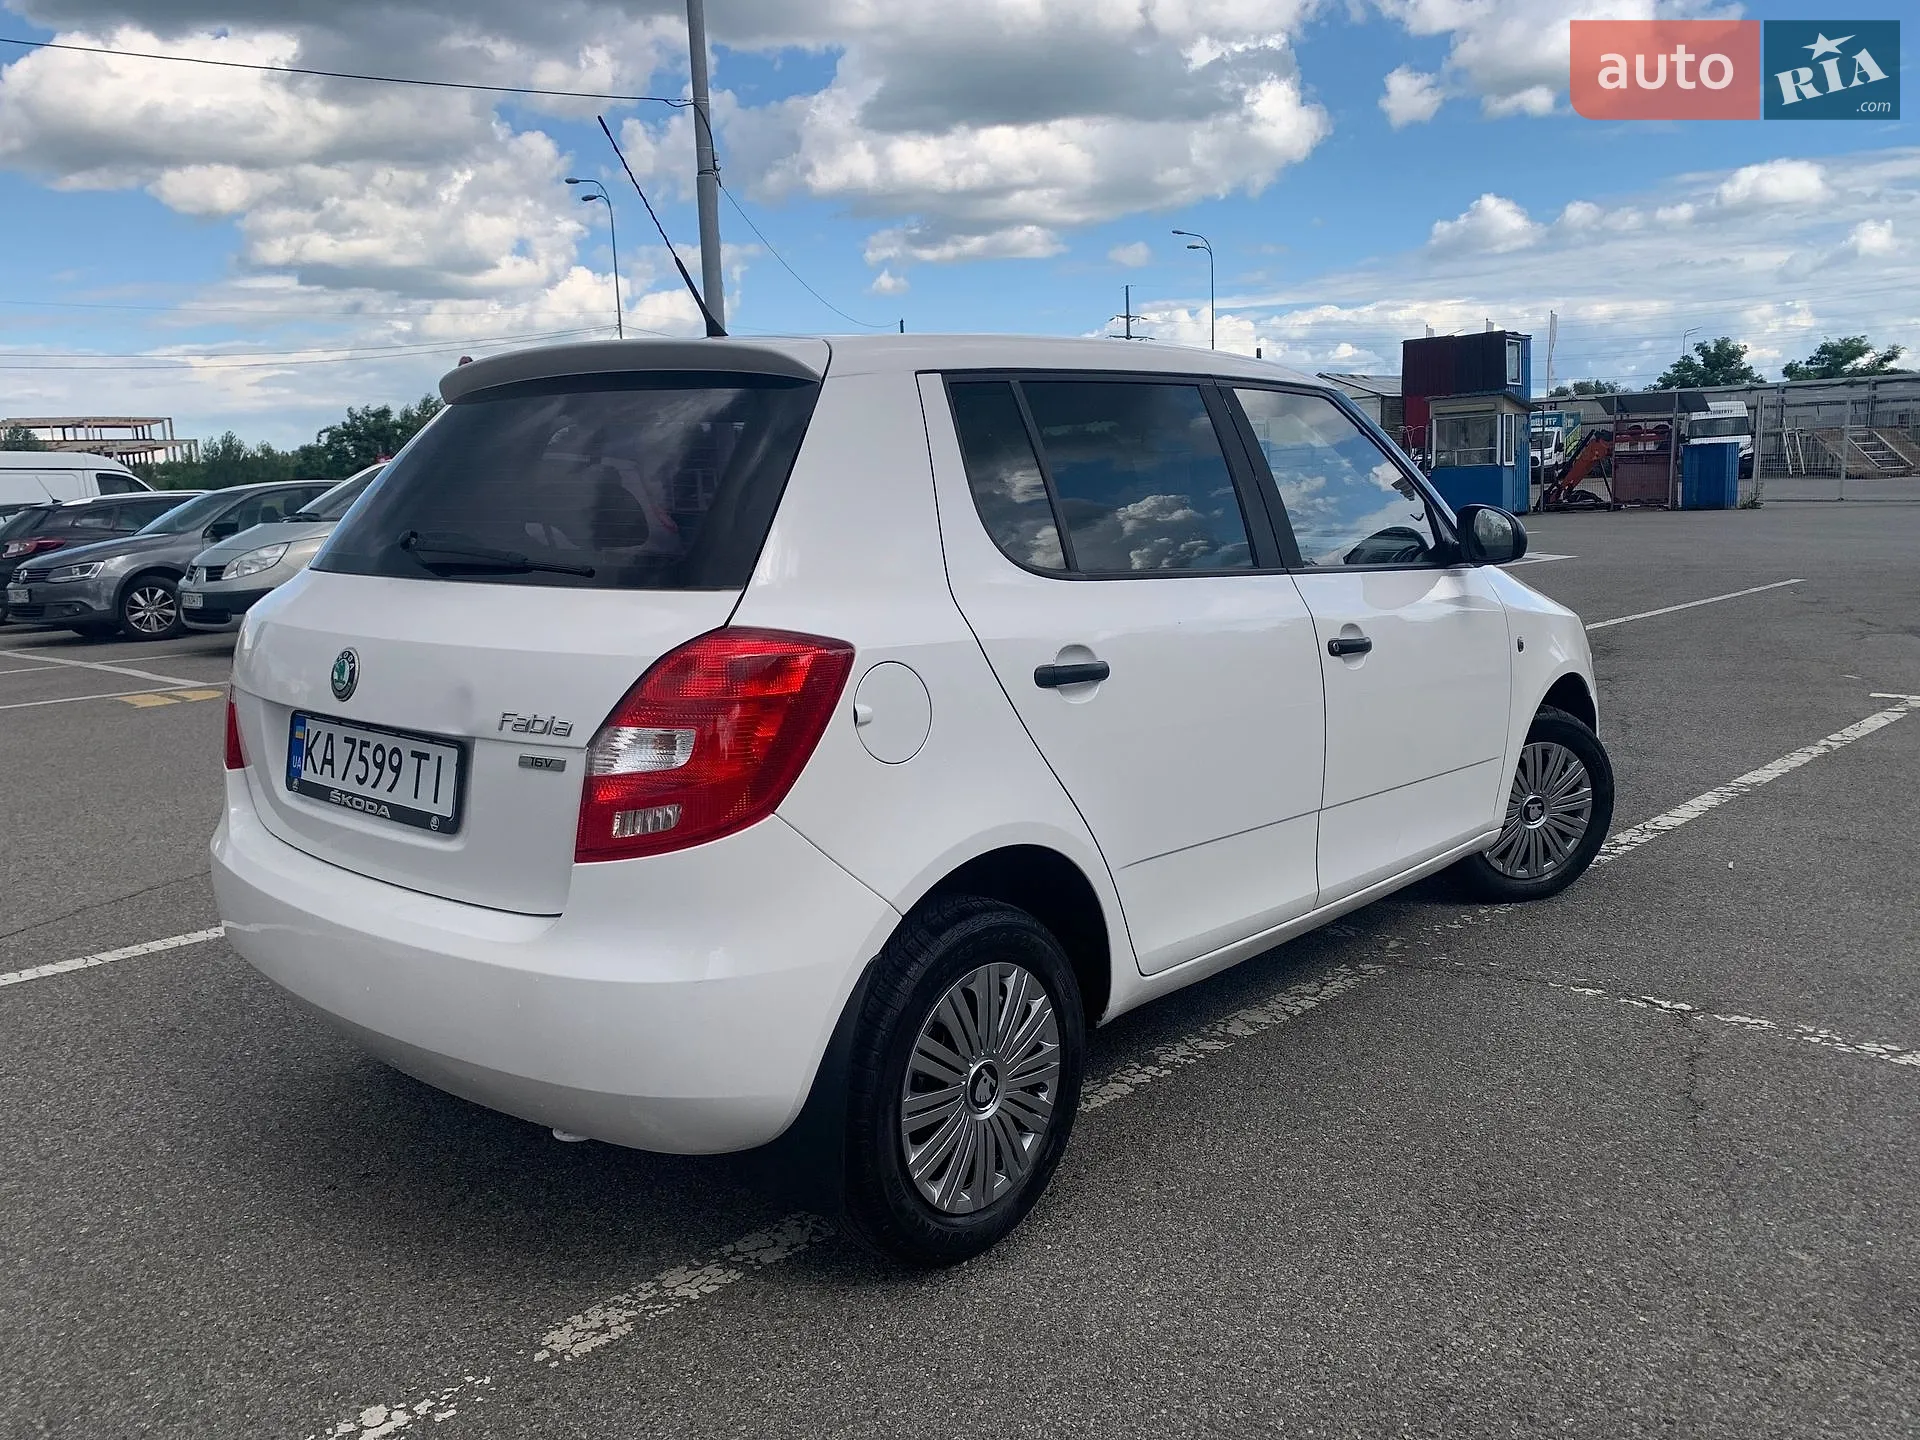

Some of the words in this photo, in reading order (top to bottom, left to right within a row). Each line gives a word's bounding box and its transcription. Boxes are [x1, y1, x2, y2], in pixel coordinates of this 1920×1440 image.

[498, 712, 574, 737] Fabia
[292, 754, 302, 770] UA
[303, 728, 335, 778] KA
[341, 736, 403, 793] 7599
[411, 750, 442, 804] TI
[530, 756, 553, 768] 16V
[329, 789, 391, 819] ŠKODA
